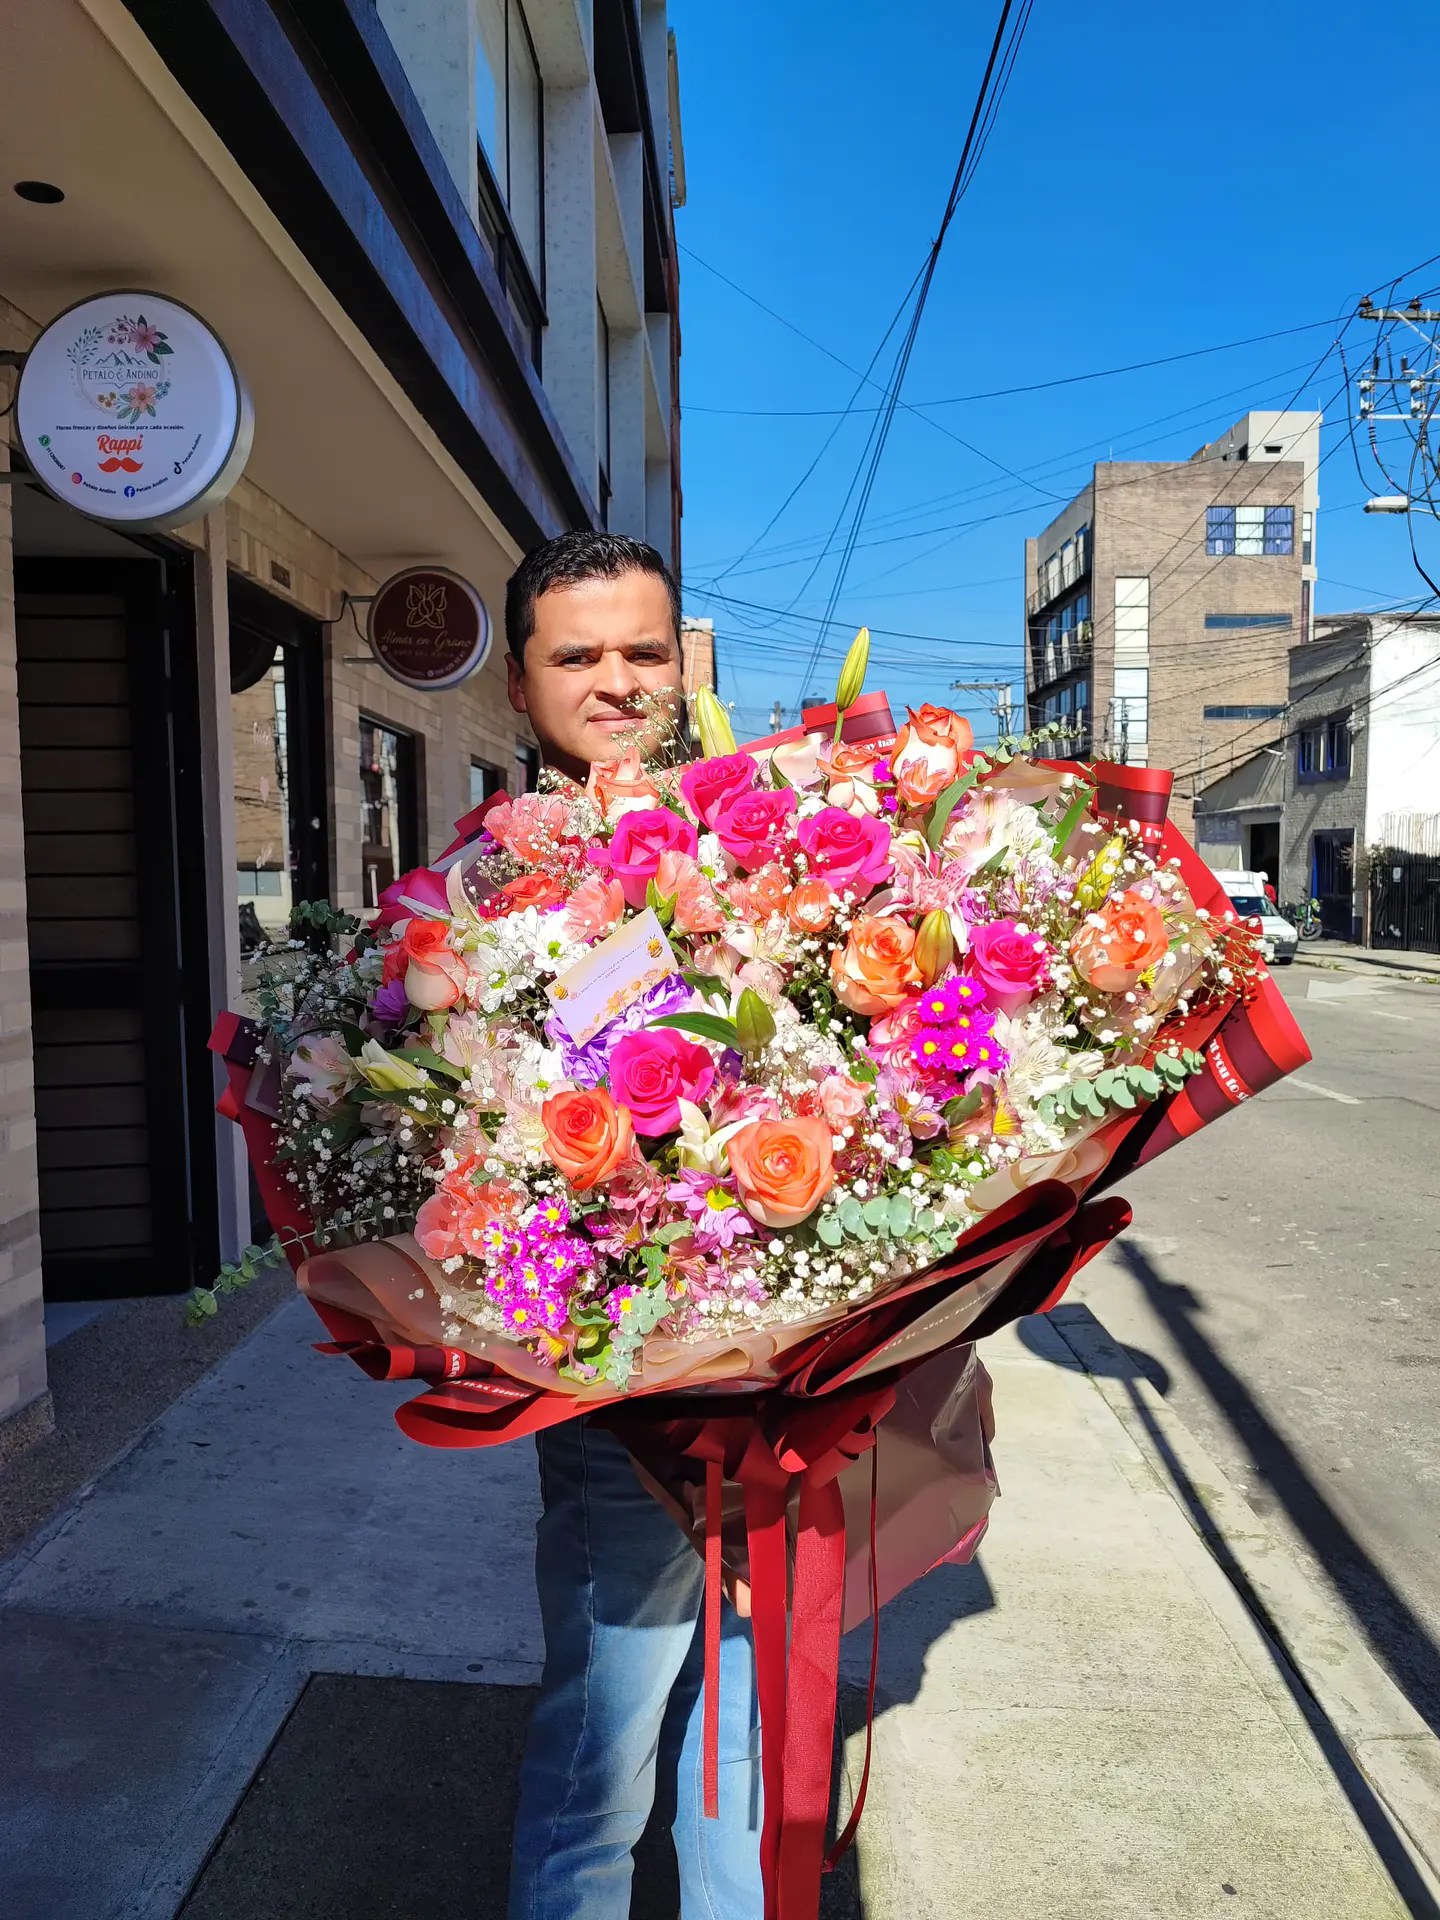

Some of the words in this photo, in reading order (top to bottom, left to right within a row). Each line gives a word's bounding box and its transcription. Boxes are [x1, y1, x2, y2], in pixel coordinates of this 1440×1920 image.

[82, 369, 114, 380] PETALO
[126, 369, 159, 380] ANDINO
[97, 434, 143, 454] Rappi
[82, 481, 98, 491] Petalo
[136, 485, 152, 493] Petalo
[152, 476, 169, 487] Andino
[378, 629, 412, 645] Almas
[416, 637, 429, 645] en
[434, 630, 472, 650] Grano
[1212, 1052, 1231, 1080] you
[1225, 1078, 1240, 1093] to
